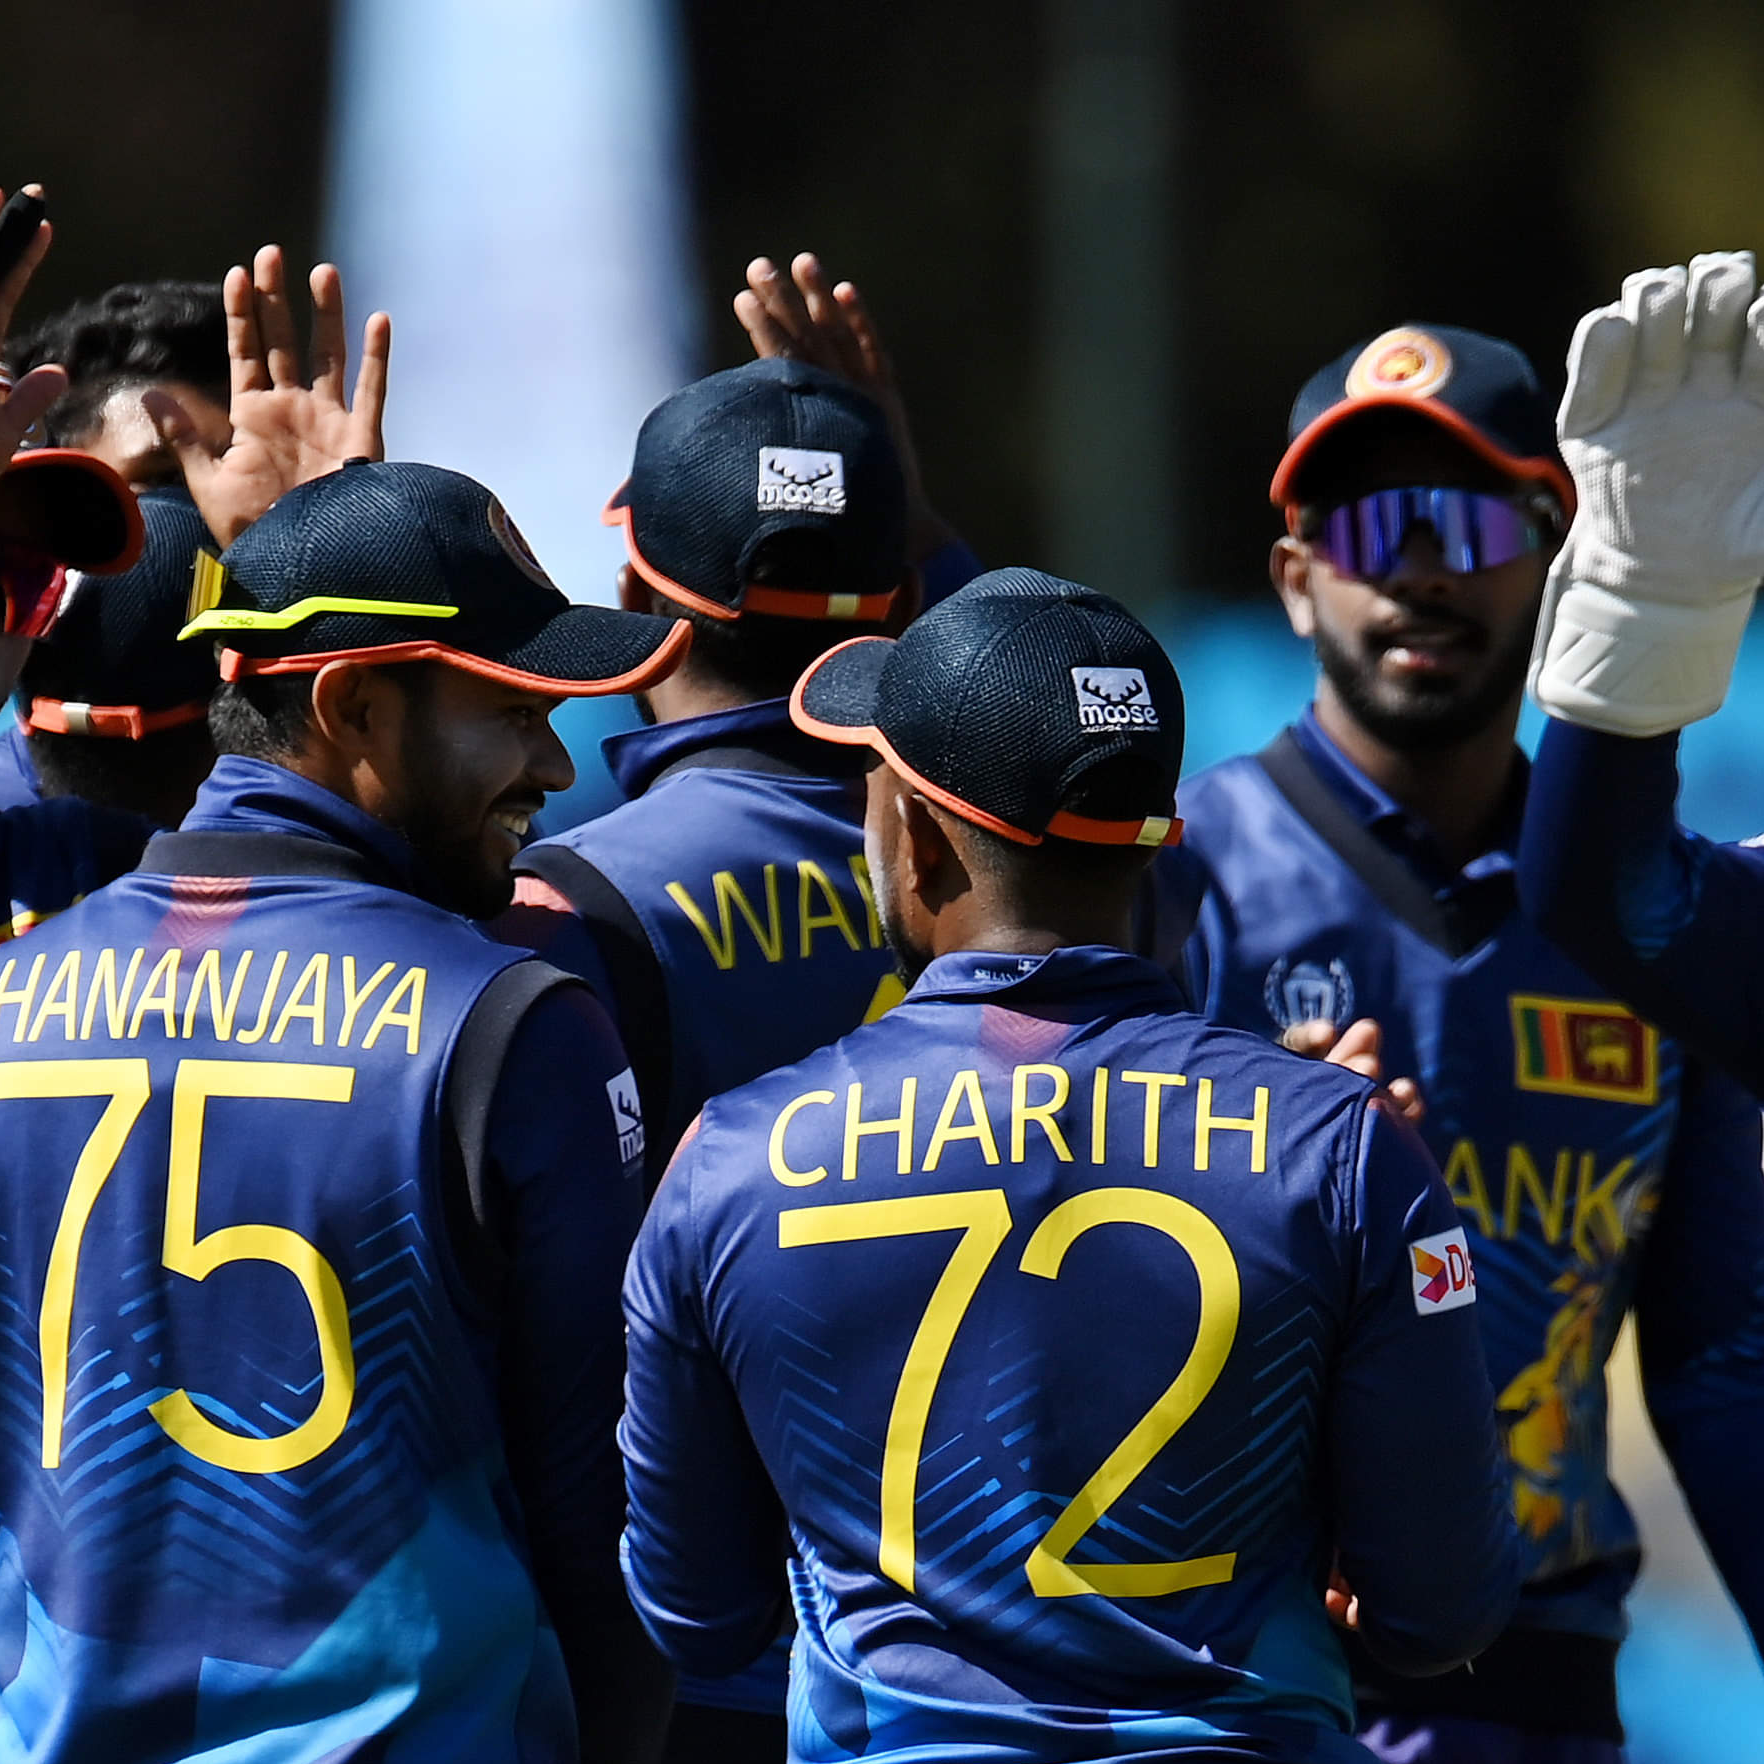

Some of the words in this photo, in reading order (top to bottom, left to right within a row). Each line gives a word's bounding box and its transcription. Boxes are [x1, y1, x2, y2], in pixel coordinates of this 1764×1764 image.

[758, 483, 847, 507] moose
[1079, 704, 1159, 725] moose
[768, 1063, 1270, 1187] CHARITH
[778, 1186, 1240, 1597] 72
